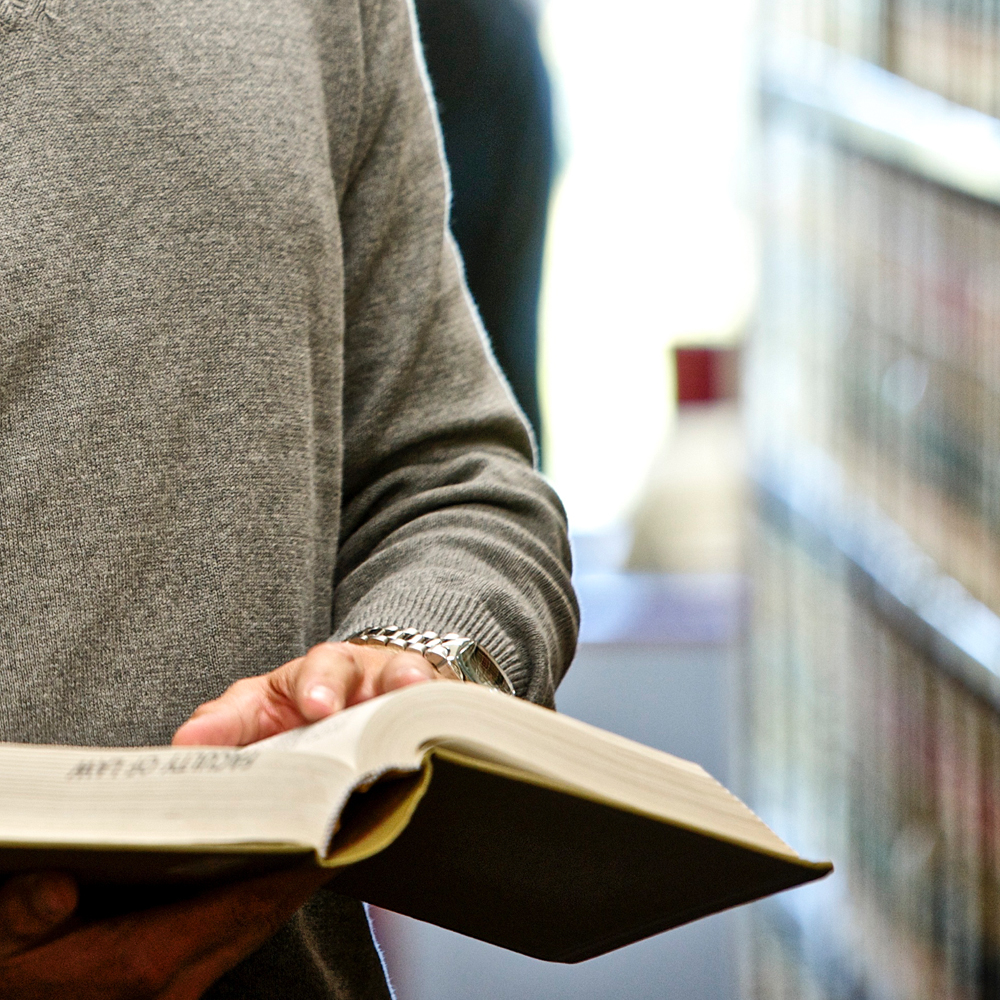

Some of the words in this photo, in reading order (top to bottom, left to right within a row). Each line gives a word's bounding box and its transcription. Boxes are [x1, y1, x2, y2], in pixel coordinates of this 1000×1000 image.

[67, 757, 125, 780] LAW
[126, 754, 159, 777] OF
[161, 751, 261, 775] FACULTY
